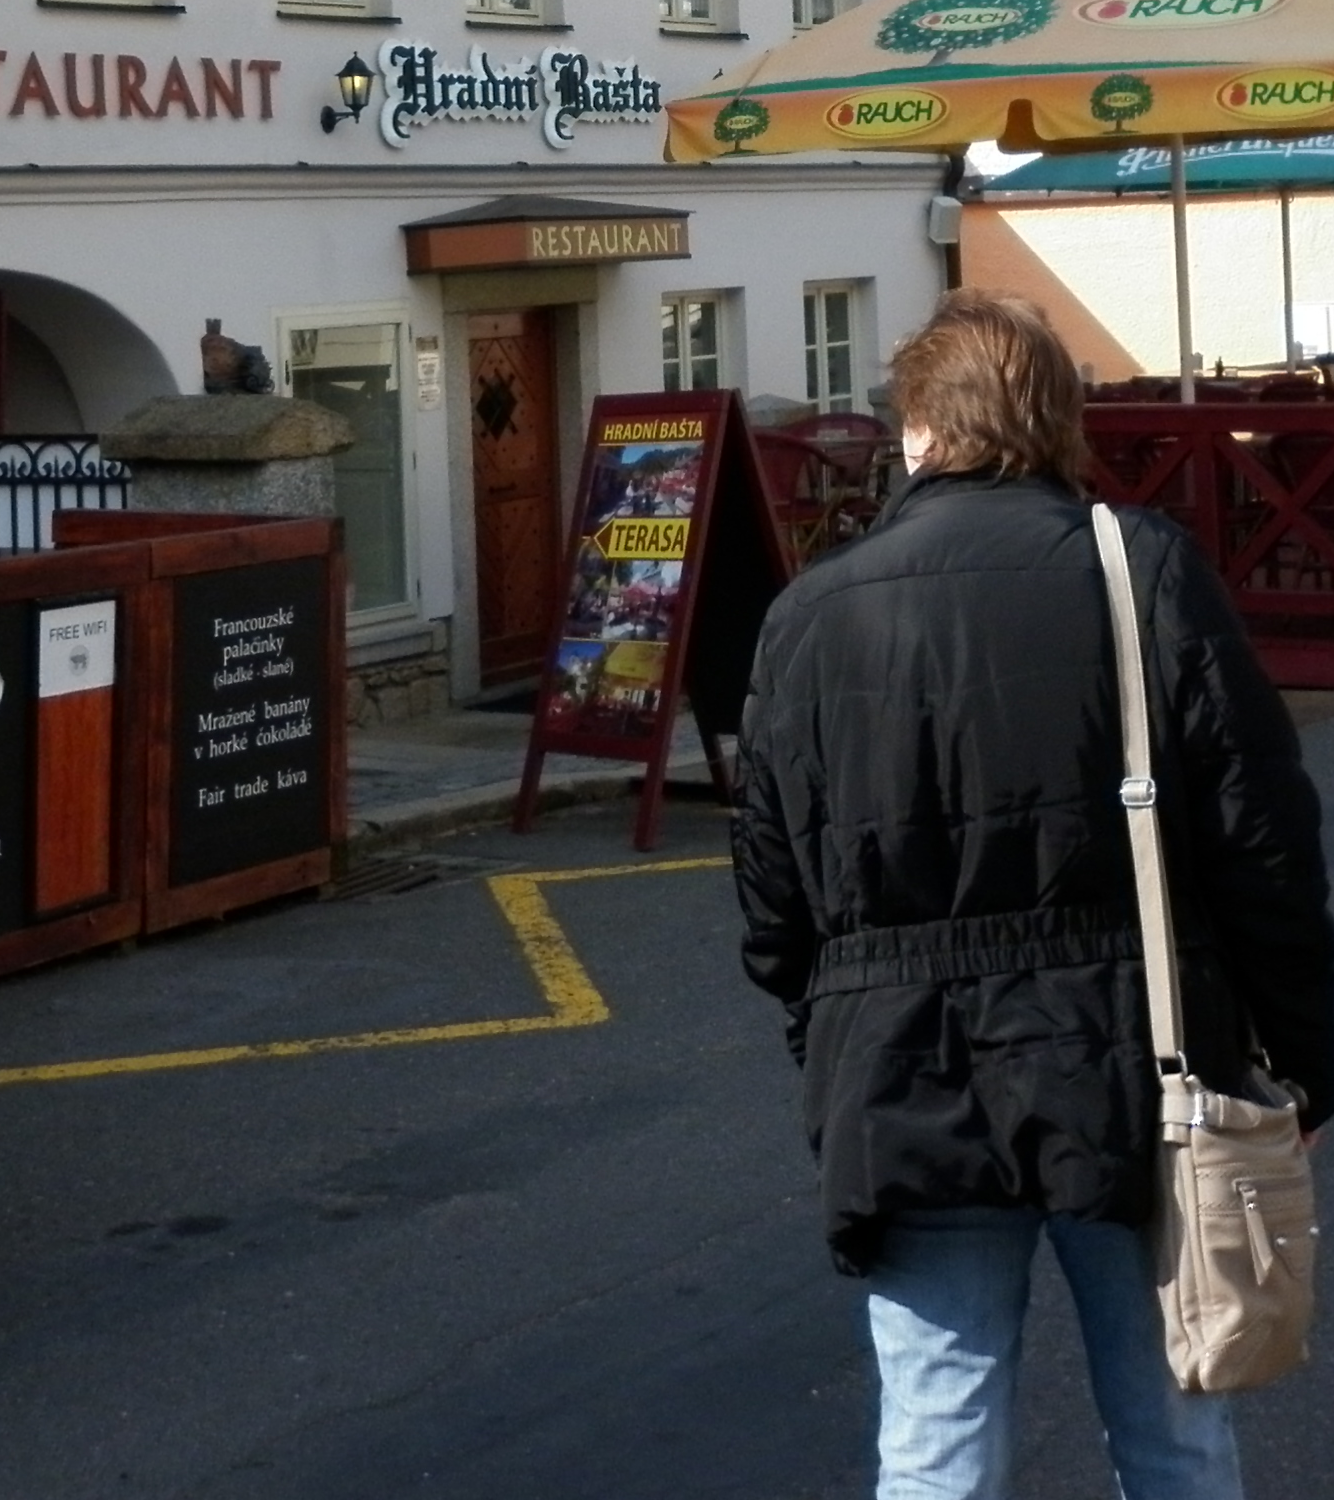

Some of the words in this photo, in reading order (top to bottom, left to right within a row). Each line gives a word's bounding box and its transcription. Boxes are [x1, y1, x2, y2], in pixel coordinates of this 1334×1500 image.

[942, 12, 1009, 25] RAUCH
[390, 45, 540, 140] Hradní
[550, 52, 664, 141] Bašta
[856, 99, 934, 126] RAUCH
[532, 222, 682, 258] RESTAURANT
[604, 419, 659, 441] HRADNÍ
[660, 417, 703, 440] BAŠTA
[614, 524, 685, 553] TERASA
[49, 623, 80, 642] FREE
[83, 620, 107, 637] WIFI
[214, 605, 295, 637] Francouzské
[223, 633, 285, 666] palačinky
[198, 703, 257, 732] Mražené
[264, 694, 311, 718] banány
[193, 746, 204, 760] v
[209, 731, 249, 758] horké
[198, 786, 226, 808] Fair
[234, 775, 270, 799] trade
[277, 767, 308, 789] káva
